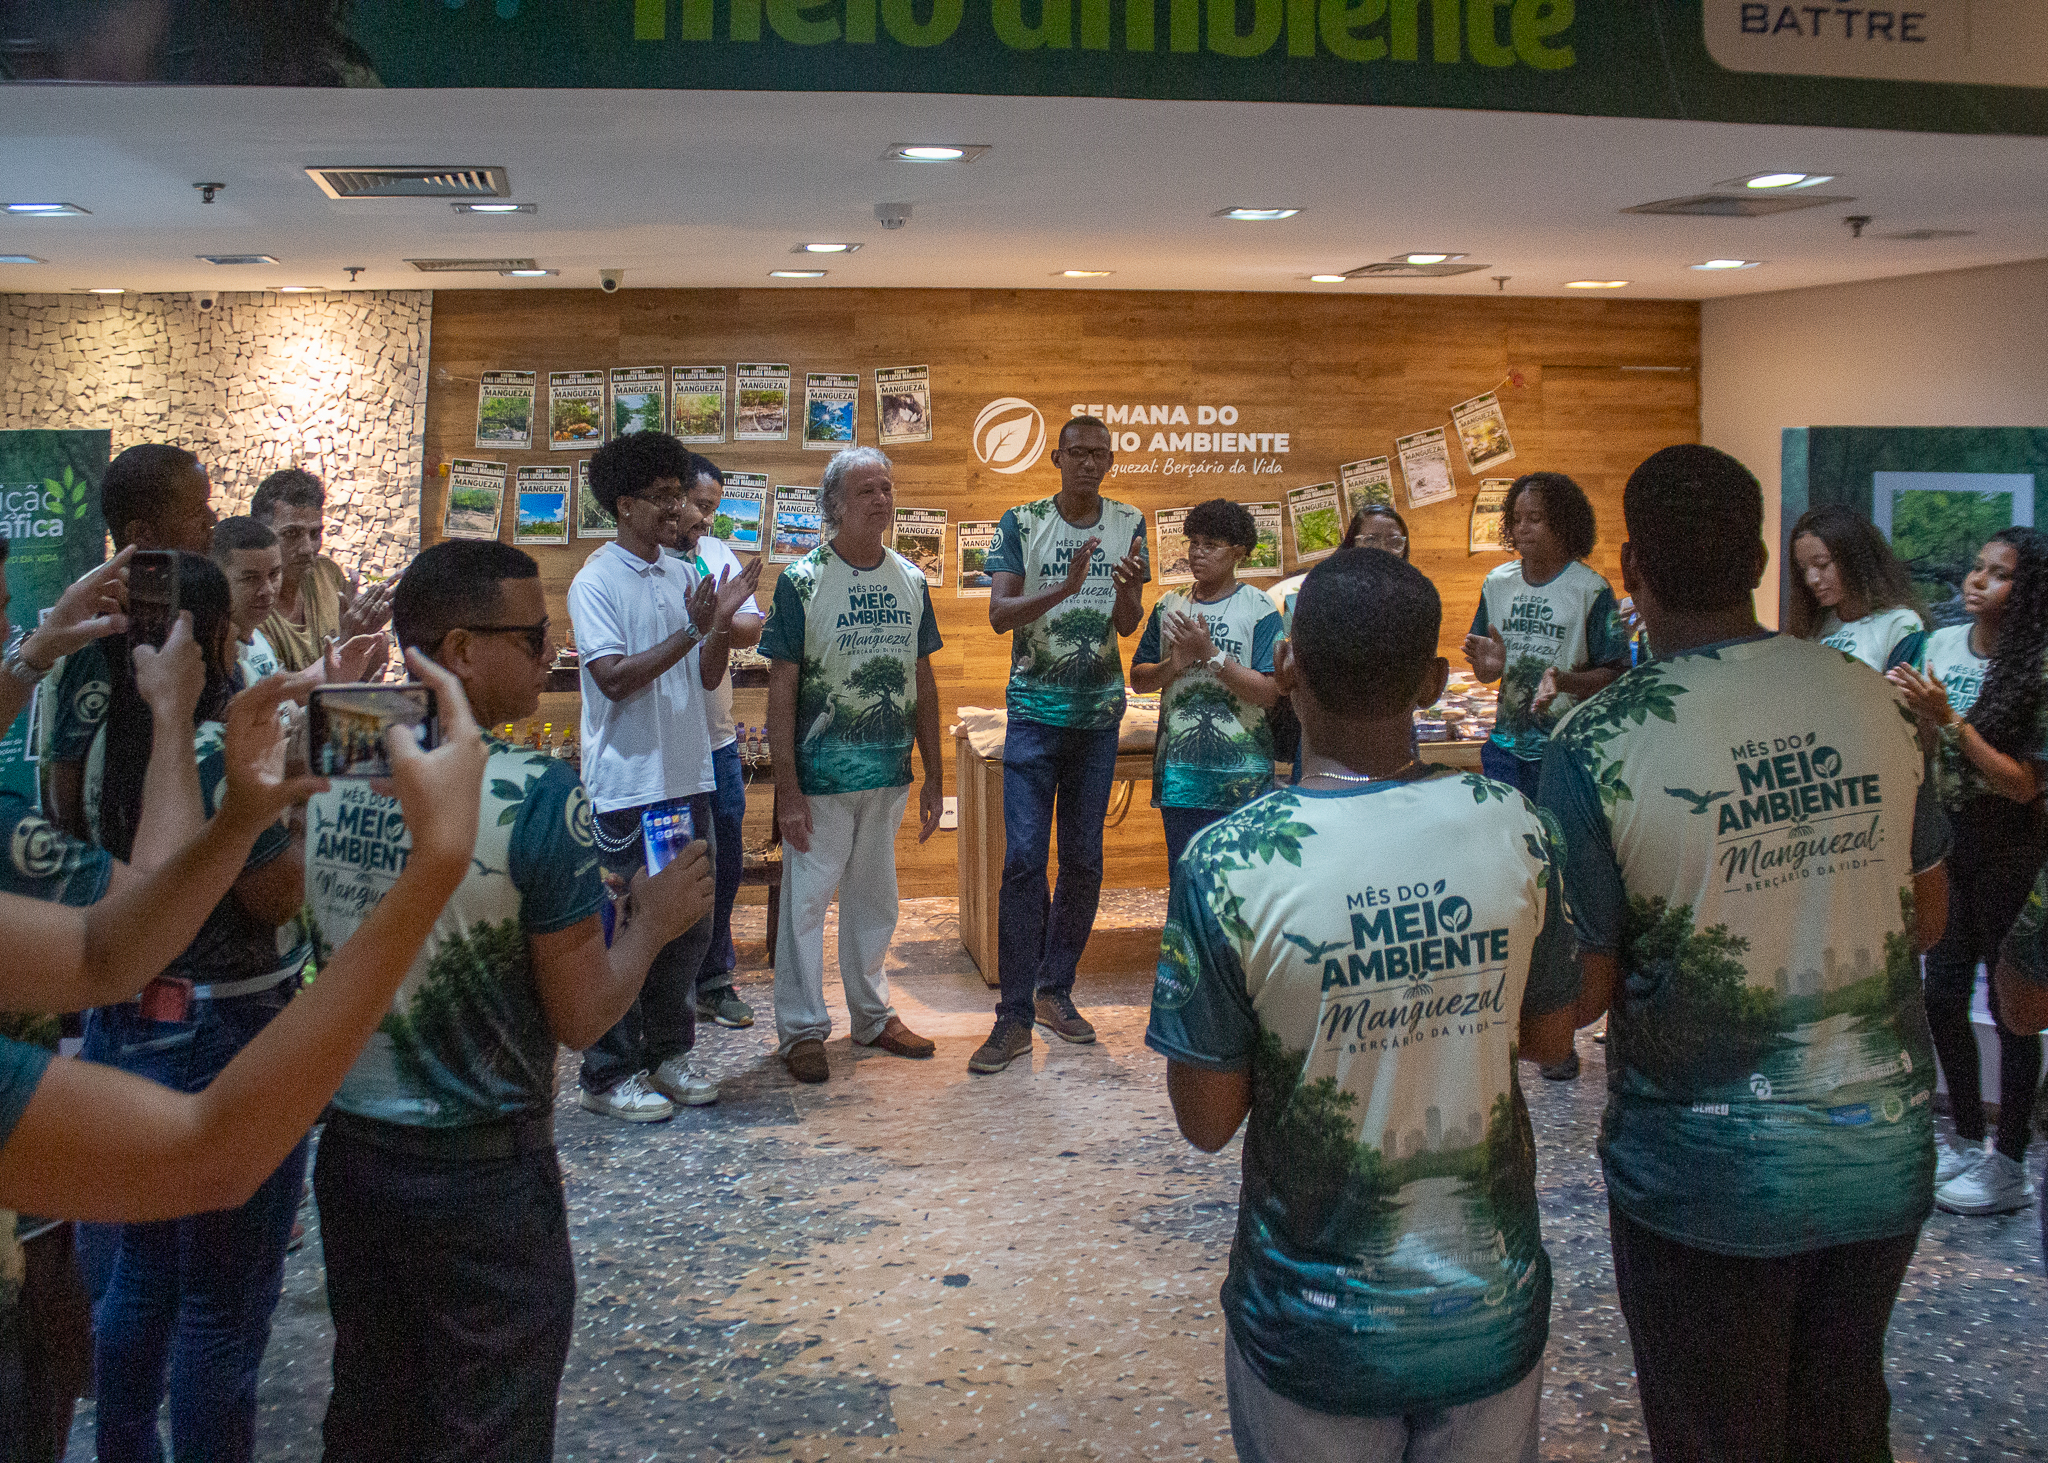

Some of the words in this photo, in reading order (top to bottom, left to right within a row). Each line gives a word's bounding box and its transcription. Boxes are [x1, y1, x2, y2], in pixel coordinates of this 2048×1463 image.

[1741, 3, 1927, 43] BATTRE
[485, 389, 532, 397] MANGUEZAL
[554, 389, 602, 398] MANGUEZAL
[615, 385, 663, 394] MANGUEZAL
[810, 392, 856, 400] MANGUEZAL
[881, 384, 926, 393] MANGUEZAL
[1070, 404, 1190, 425] SEMANA
[1198, 405, 1239, 425] DO
[1110, 432, 1141, 452] IO
[1147, 432, 1290, 453] AMBIENTE
[1108, 458, 1159, 478] guezal:
[1162, 457, 1224, 478] Berçário
[1229, 459, 1247, 474] da
[1253, 458, 1284, 475] Vida
[454, 478, 502, 489] MANGUEZAL
[898, 527, 943, 535] MANGUEZAL
[963, 539, 991, 547] MANGU
[1056, 538, 1074, 547] MÊS
[848, 583, 866, 594] MÊS
[849, 593, 897, 611] MEIO
[1531, 596, 1543, 604] DO
[836, 609, 912, 628] AMBIENTE
[1510, 603, 1554, 621] MEIO
[1502, 618, 1566, 640] AMBIENTE
[1942, 673, 1982, 697] MEI
[1731, 740, 1770, 761] MÊS
[1774, 735, 1802, 753] DO
[1737, 746, 1842, 796] MEIO
[342, 787, 366, 804] MÊS
[1718, 773, 1882, 836] AMBIENTE
[336, 804, 404, 843] MEIO
[316, 833, 410, 872] AMBIENT
[1817, 865, 1836, 877] DA
[1347, 886, 1391, 910] MÊS
[1397, 882, 1429, 902] DO
[1350, 895, 1473, 951] MEIO
[1321, 928, 1509, 993] AMBIENTE
[1349, 1031, 1424, 1054] BERÇÁRIO
[1431, 1026, 1450, 1038] DA
[1458, 1021, 1490, 1036] VIDA
